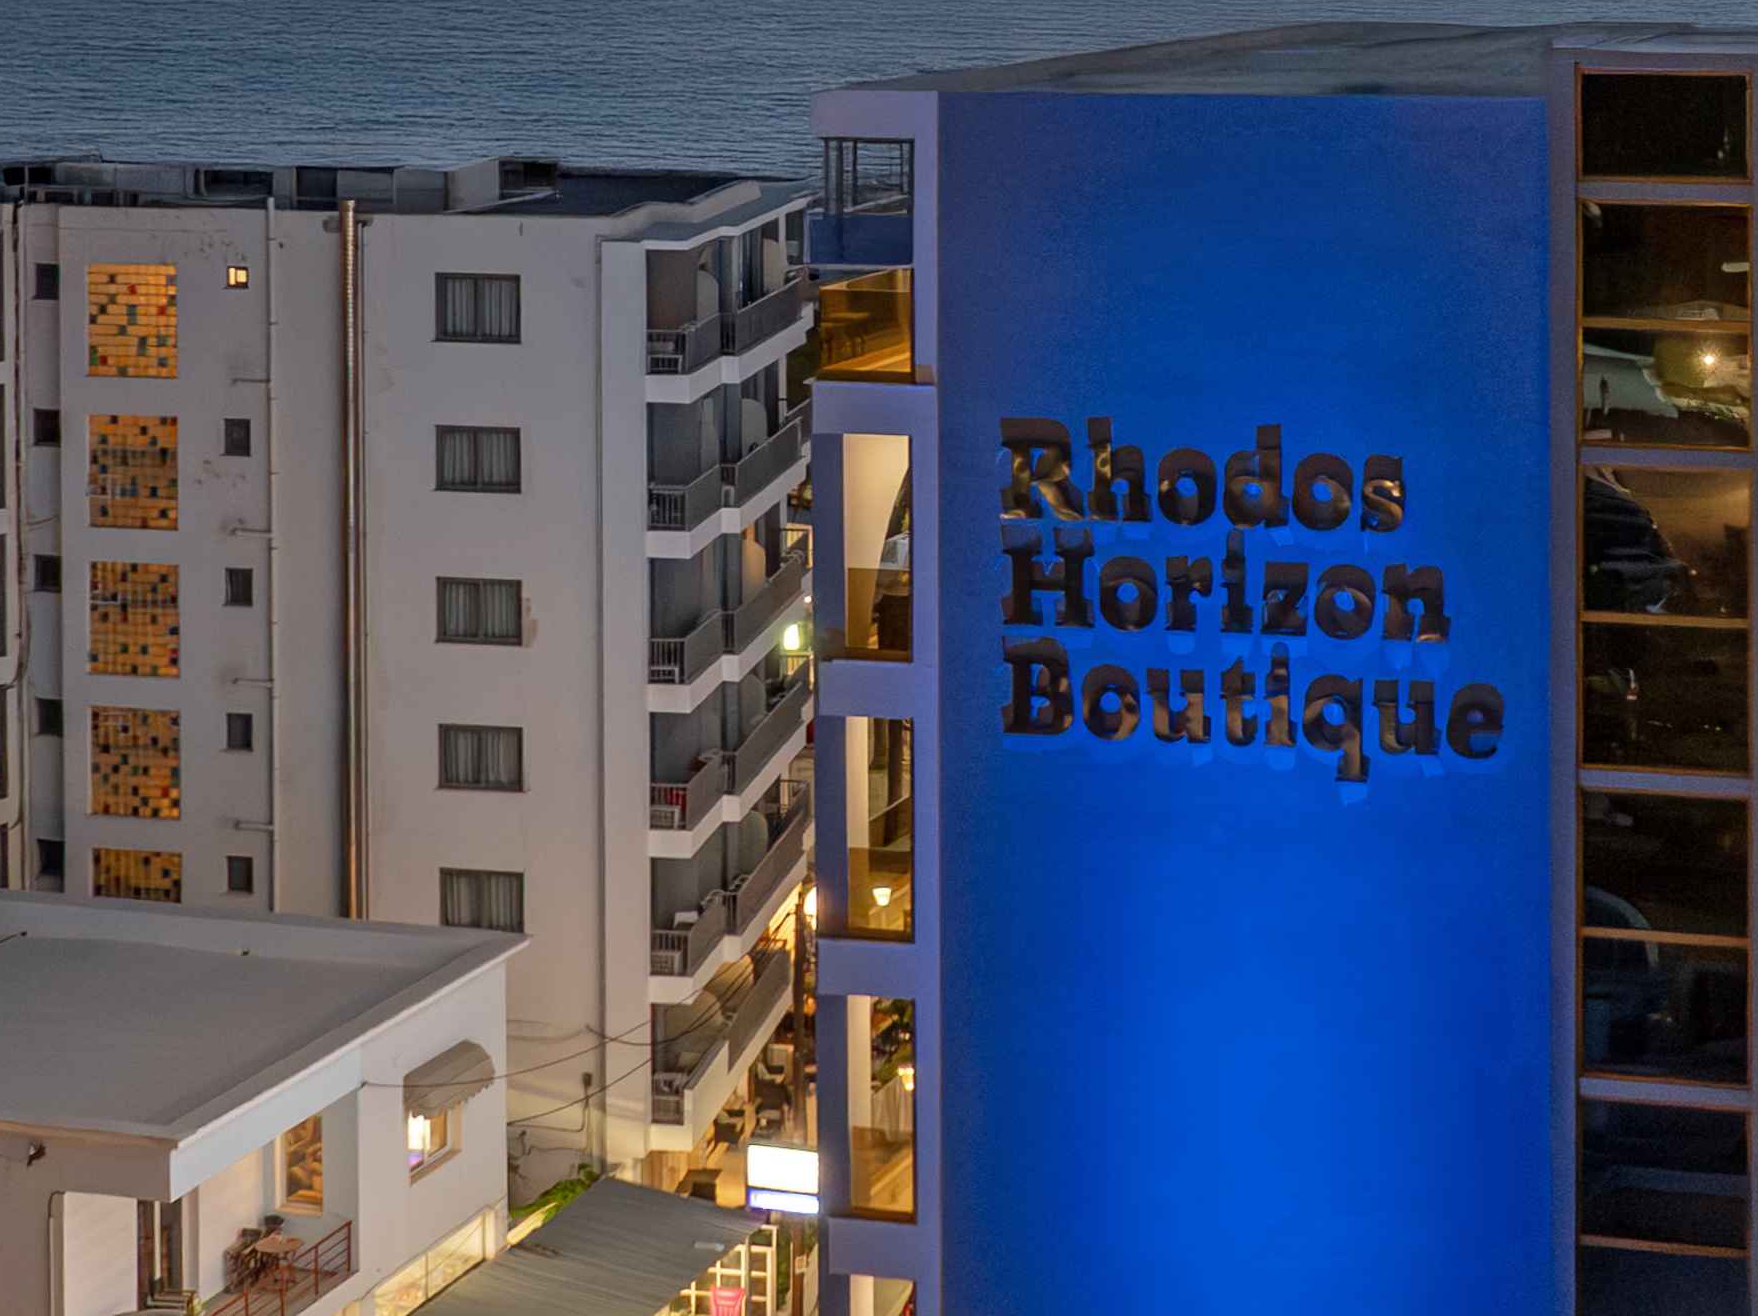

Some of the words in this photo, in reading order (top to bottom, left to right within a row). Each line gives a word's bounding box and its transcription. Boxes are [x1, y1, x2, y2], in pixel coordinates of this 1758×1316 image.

[1000, 417, 1406, 532] Rhodos
[1000, 527, 1452, 642] Horizon
[1000, 636, 1506, 783] Boutique
